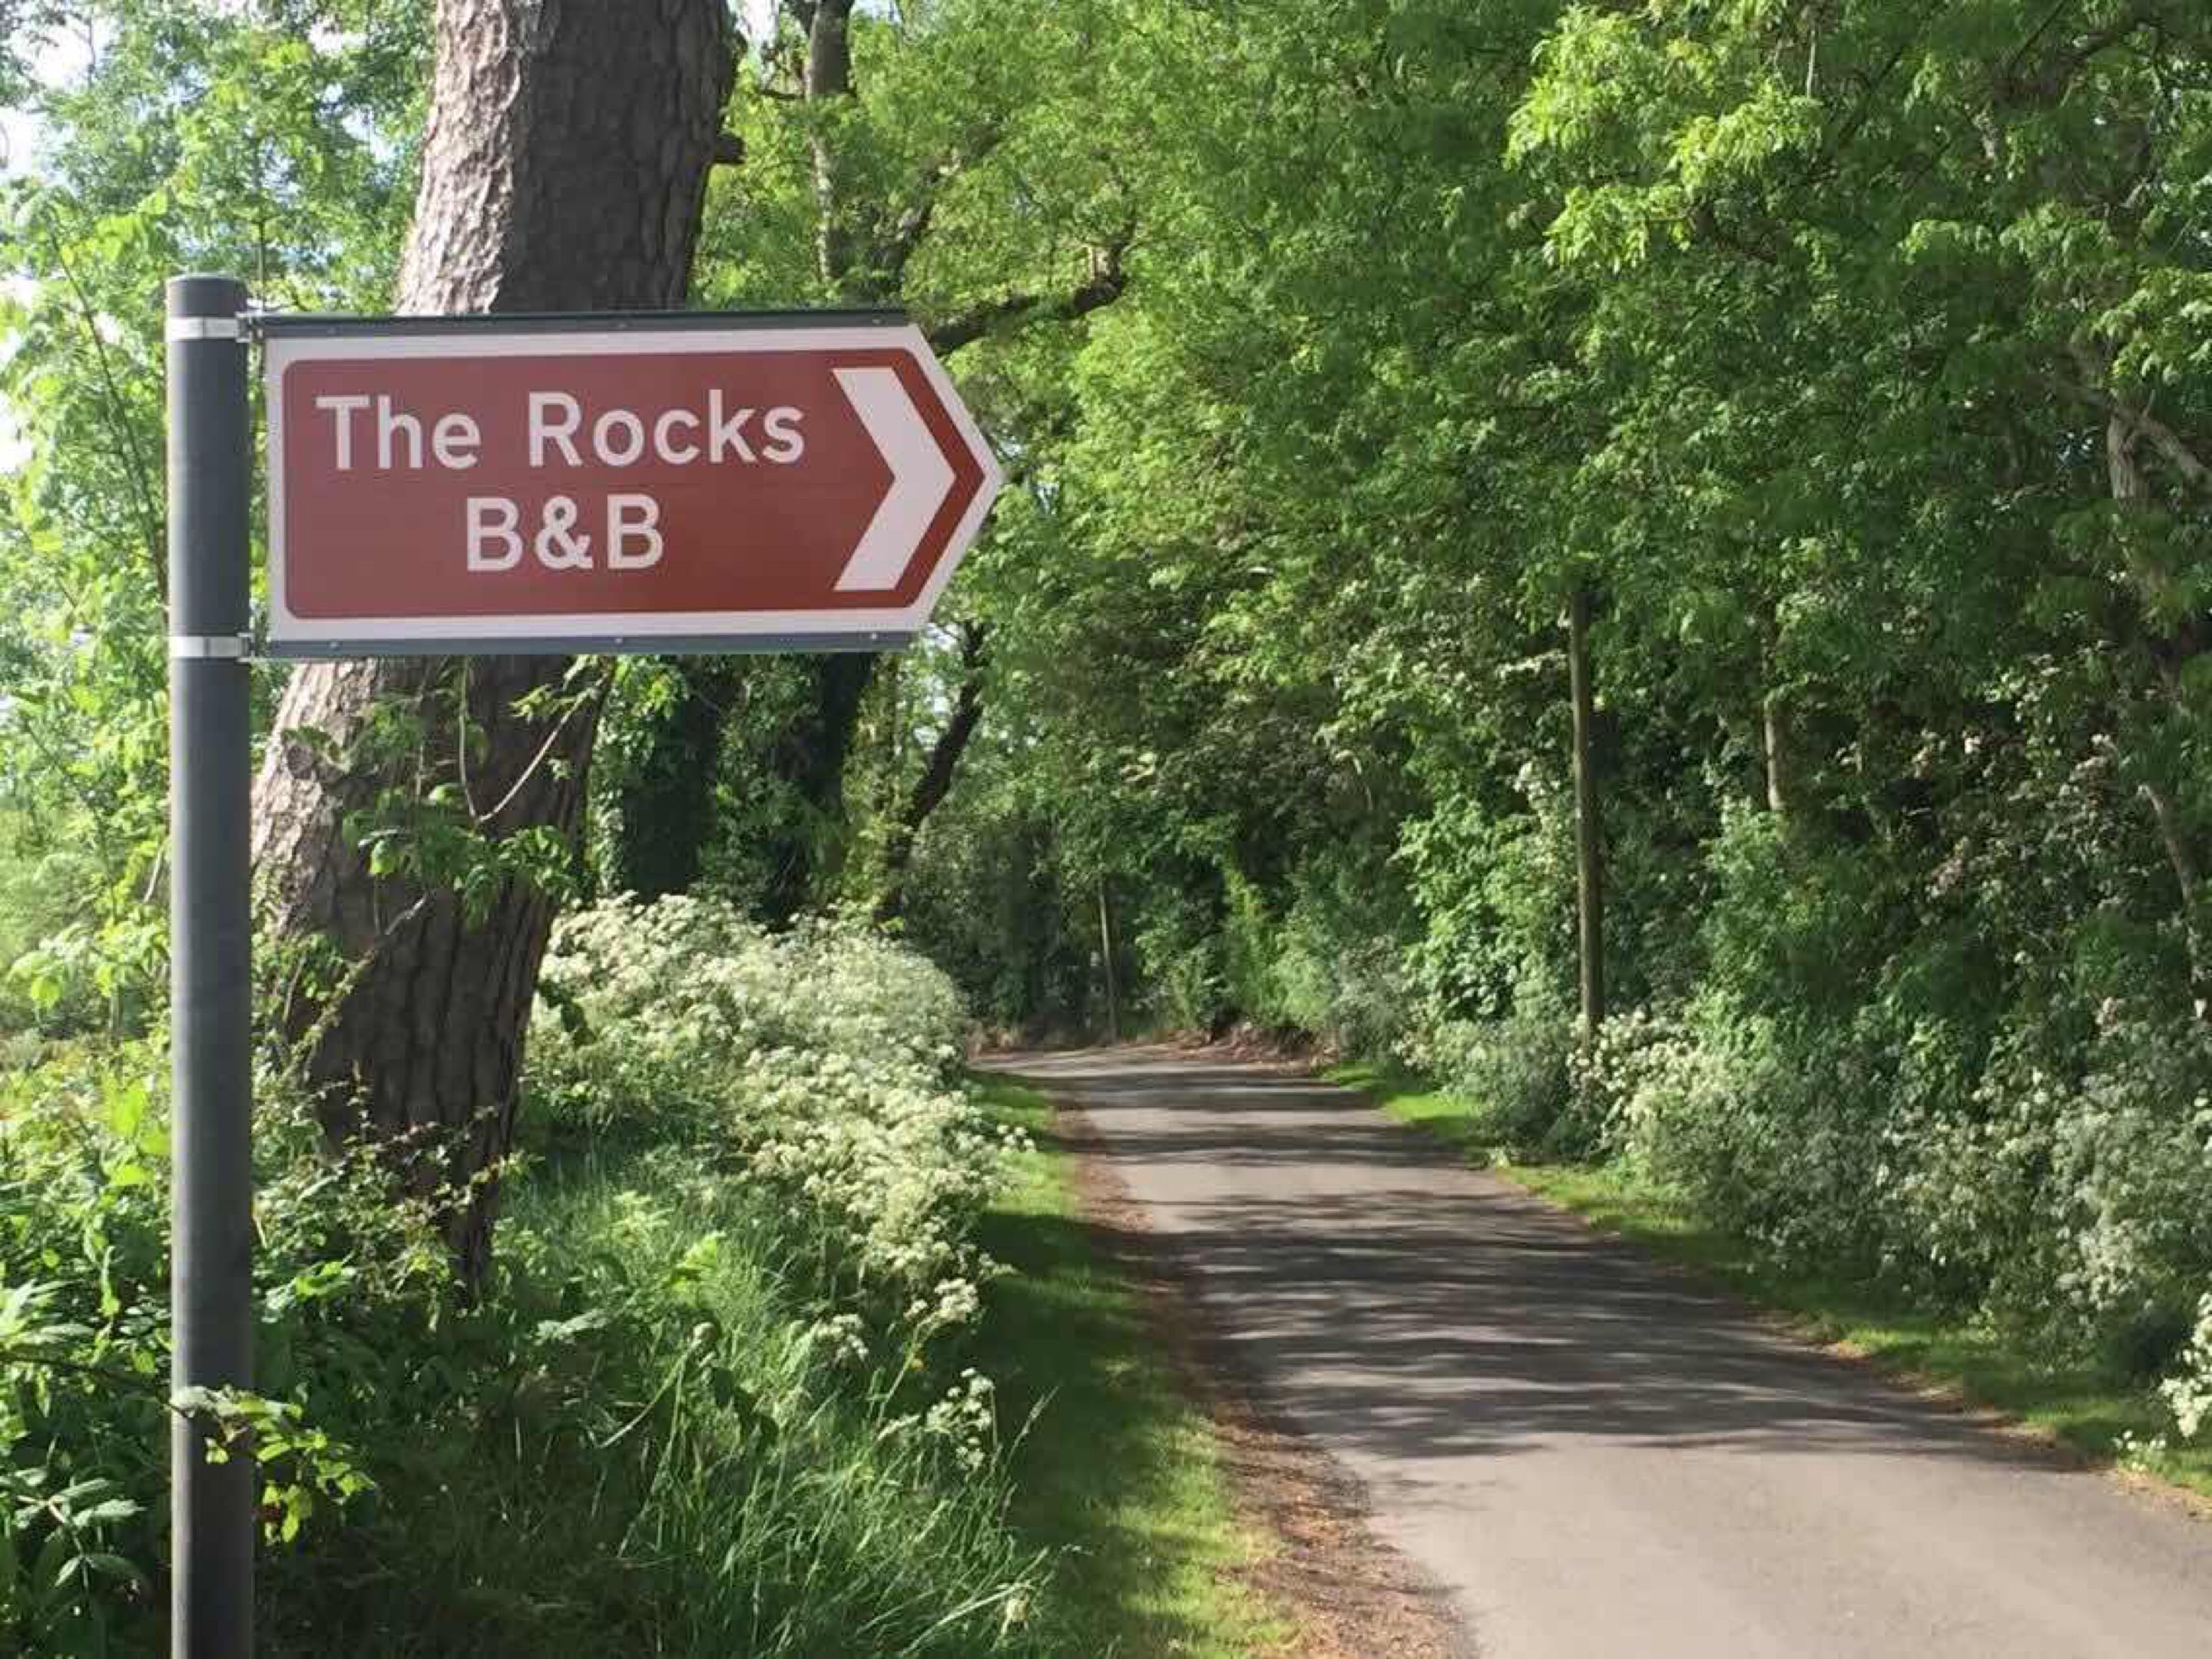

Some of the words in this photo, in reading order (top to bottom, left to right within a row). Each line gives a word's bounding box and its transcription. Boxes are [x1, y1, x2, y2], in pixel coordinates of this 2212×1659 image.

[315, 394, 482, 470] The
[528, 389, 805, 467] Rocks
[465, 494, 663, 571] B&B
